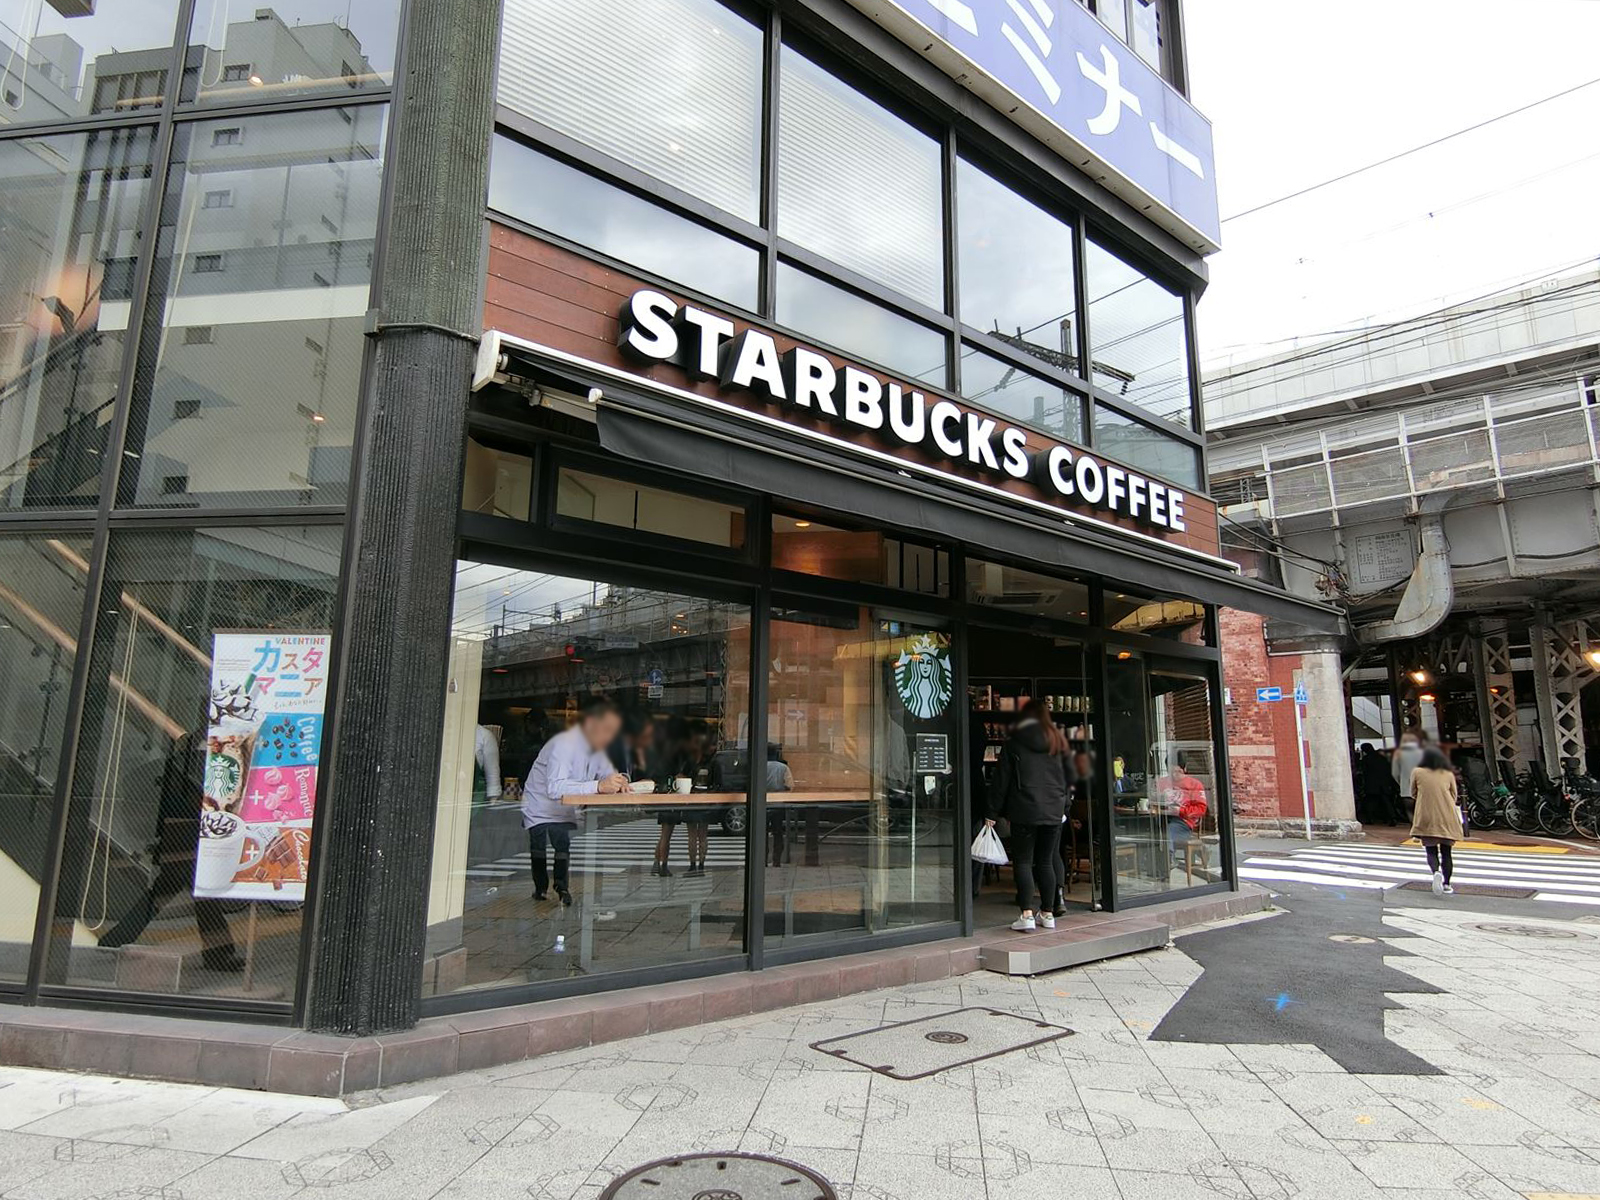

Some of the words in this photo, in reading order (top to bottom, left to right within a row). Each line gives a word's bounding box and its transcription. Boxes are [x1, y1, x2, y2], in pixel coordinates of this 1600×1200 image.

[627, 289, 1029, 479] STARBUCKS
[1047, 445, 1185, 532] COFFEE
[252, 640, 323, 673] カスタ
[275, 637, 325, 645] VALENTINE
[297, 716, 317, 761] Coffee
